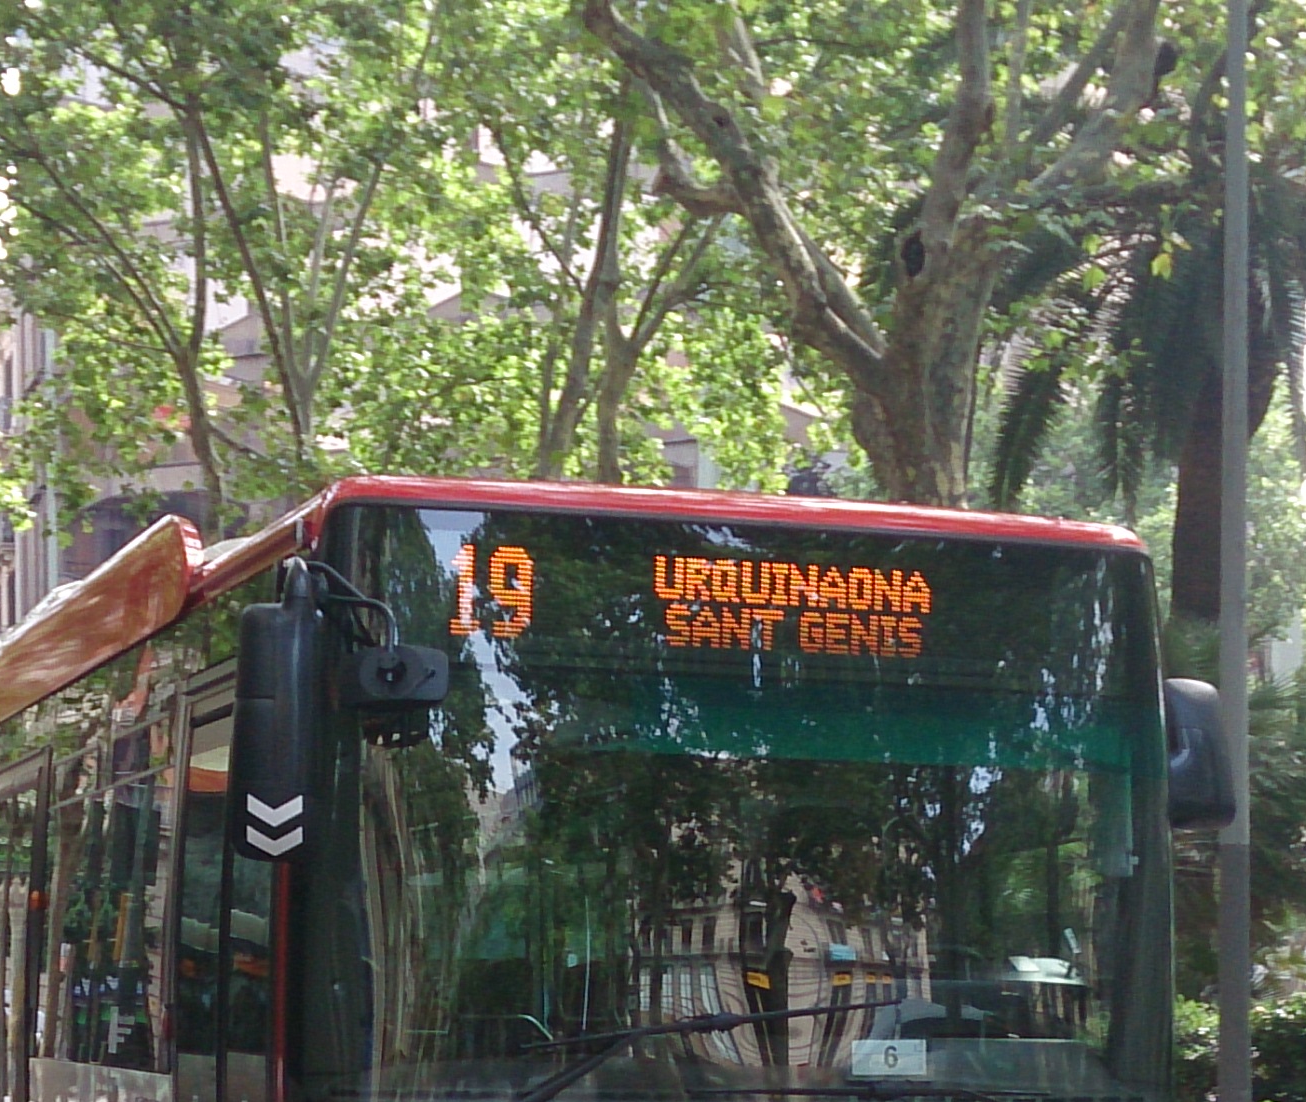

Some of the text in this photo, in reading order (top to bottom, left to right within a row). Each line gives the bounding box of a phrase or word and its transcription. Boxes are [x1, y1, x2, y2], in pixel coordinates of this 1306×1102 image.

[449, 544, 534, 638] 19
[654, 555, 932, 614] URQUINAONA
[665, 604, 924, 658] SANT GENIS
[883, 1045, 899, 1069] 6
